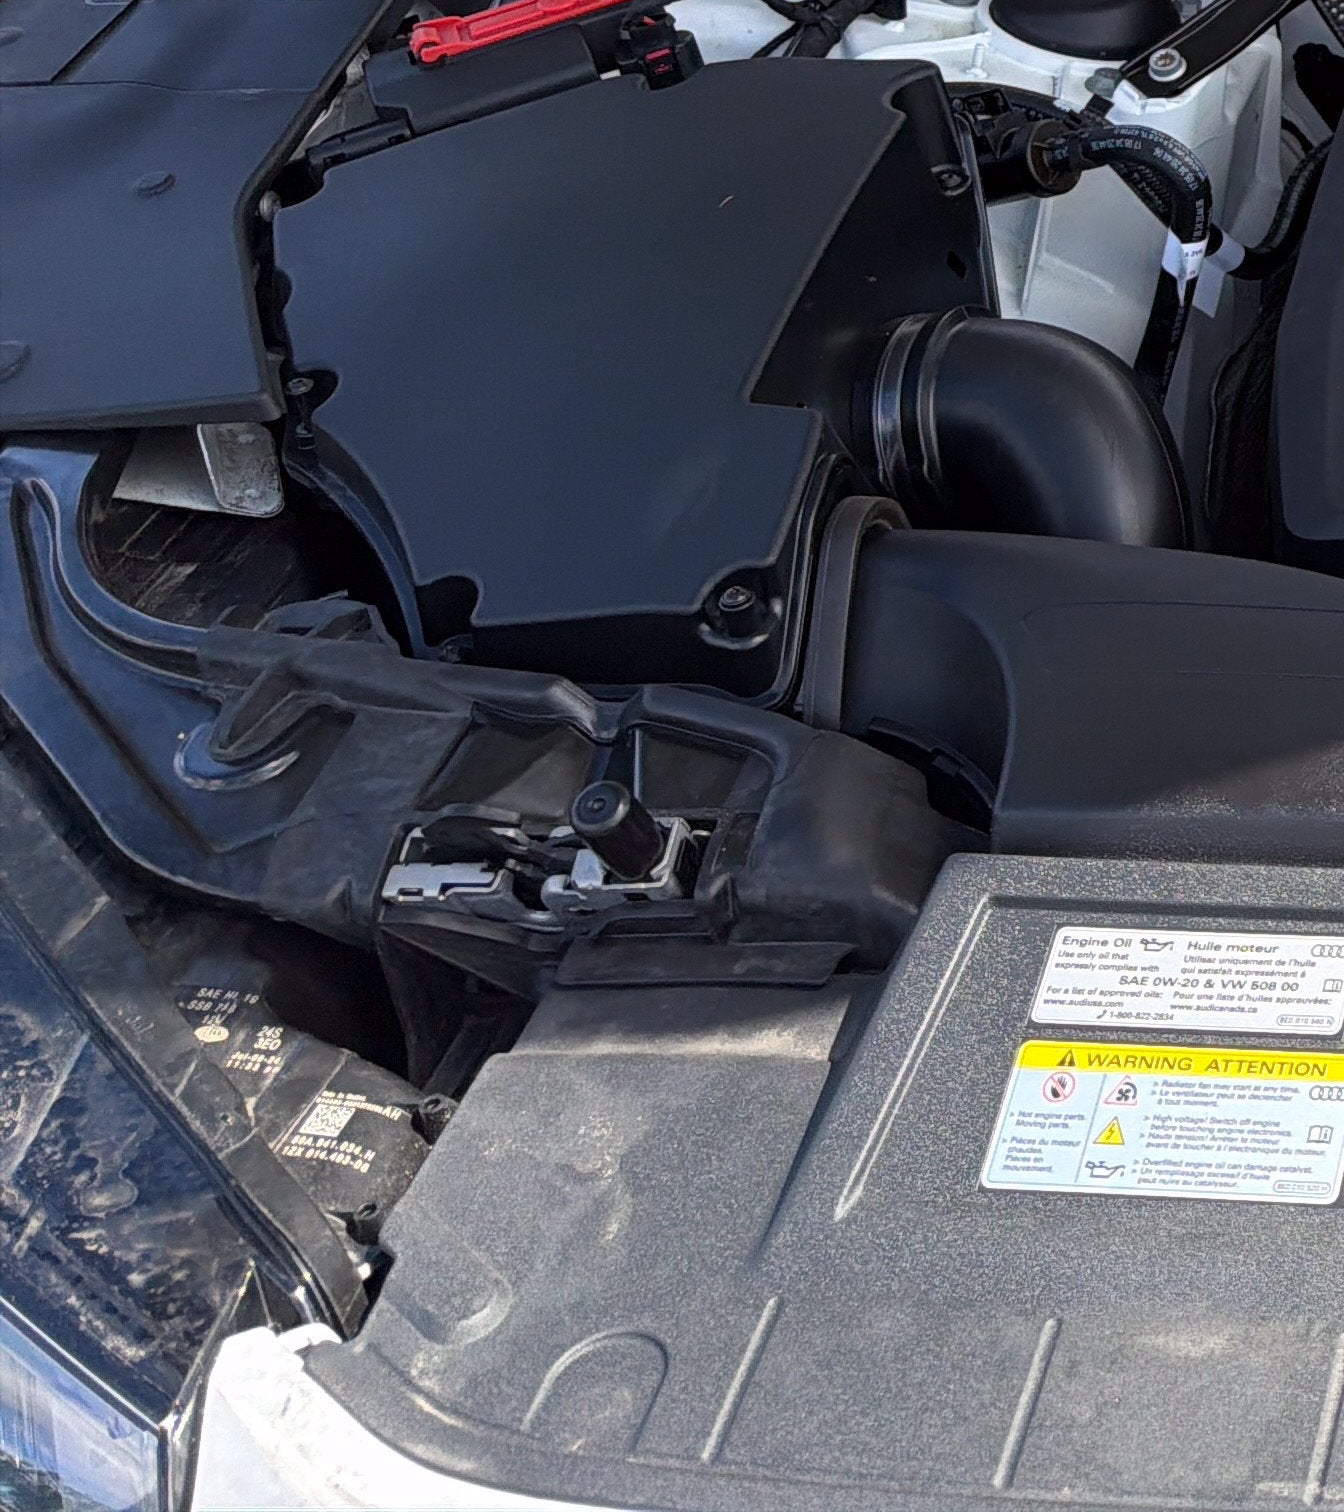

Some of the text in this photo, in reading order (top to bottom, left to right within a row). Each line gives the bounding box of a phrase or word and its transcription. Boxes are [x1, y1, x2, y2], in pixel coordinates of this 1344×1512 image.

[1061, 935, 1132, 947] Engine Oil
[1186, 940, 1279, 953] Huile moteur
[1057, 949, 1129, 960] Use only oil that
[1183, 954, 1216, 963] Utilisez
[1274, 958, 1286, 966] de
[1287, 958, 1316, 967] l'huile
[1054, 962, 1159, 972] expressly complies with
[1180, 966, 1196, 974] qui
[1197, 967, 1232, 975] satisfait
[1118, 975, 1299, 991] SAE 0W-20 & VW 508 00
[197, 987, 223, 999] SAE
[1045, 985, 1062, 994] For
[1071, 986, 1085, 995] list
[1086, 987, 1098, 995] of
[1098, 989, 1142, 997] approved
[1143, 990, 1163, 998] oils:
[1172, 990, 1195, 999] Pour
[1215, 992, 1235, 1001] liste
[1236, 993, 1273, 1002] d'huiles
[1042, 998, 1124, 1007] www.audiusa.com
[1169, 1003, 1257, 1013] www.audicanada.ca
[256, 1026, 284, 1039] 24S
[1087, 1053, 1327, 1076] WARNING ATTENTION
